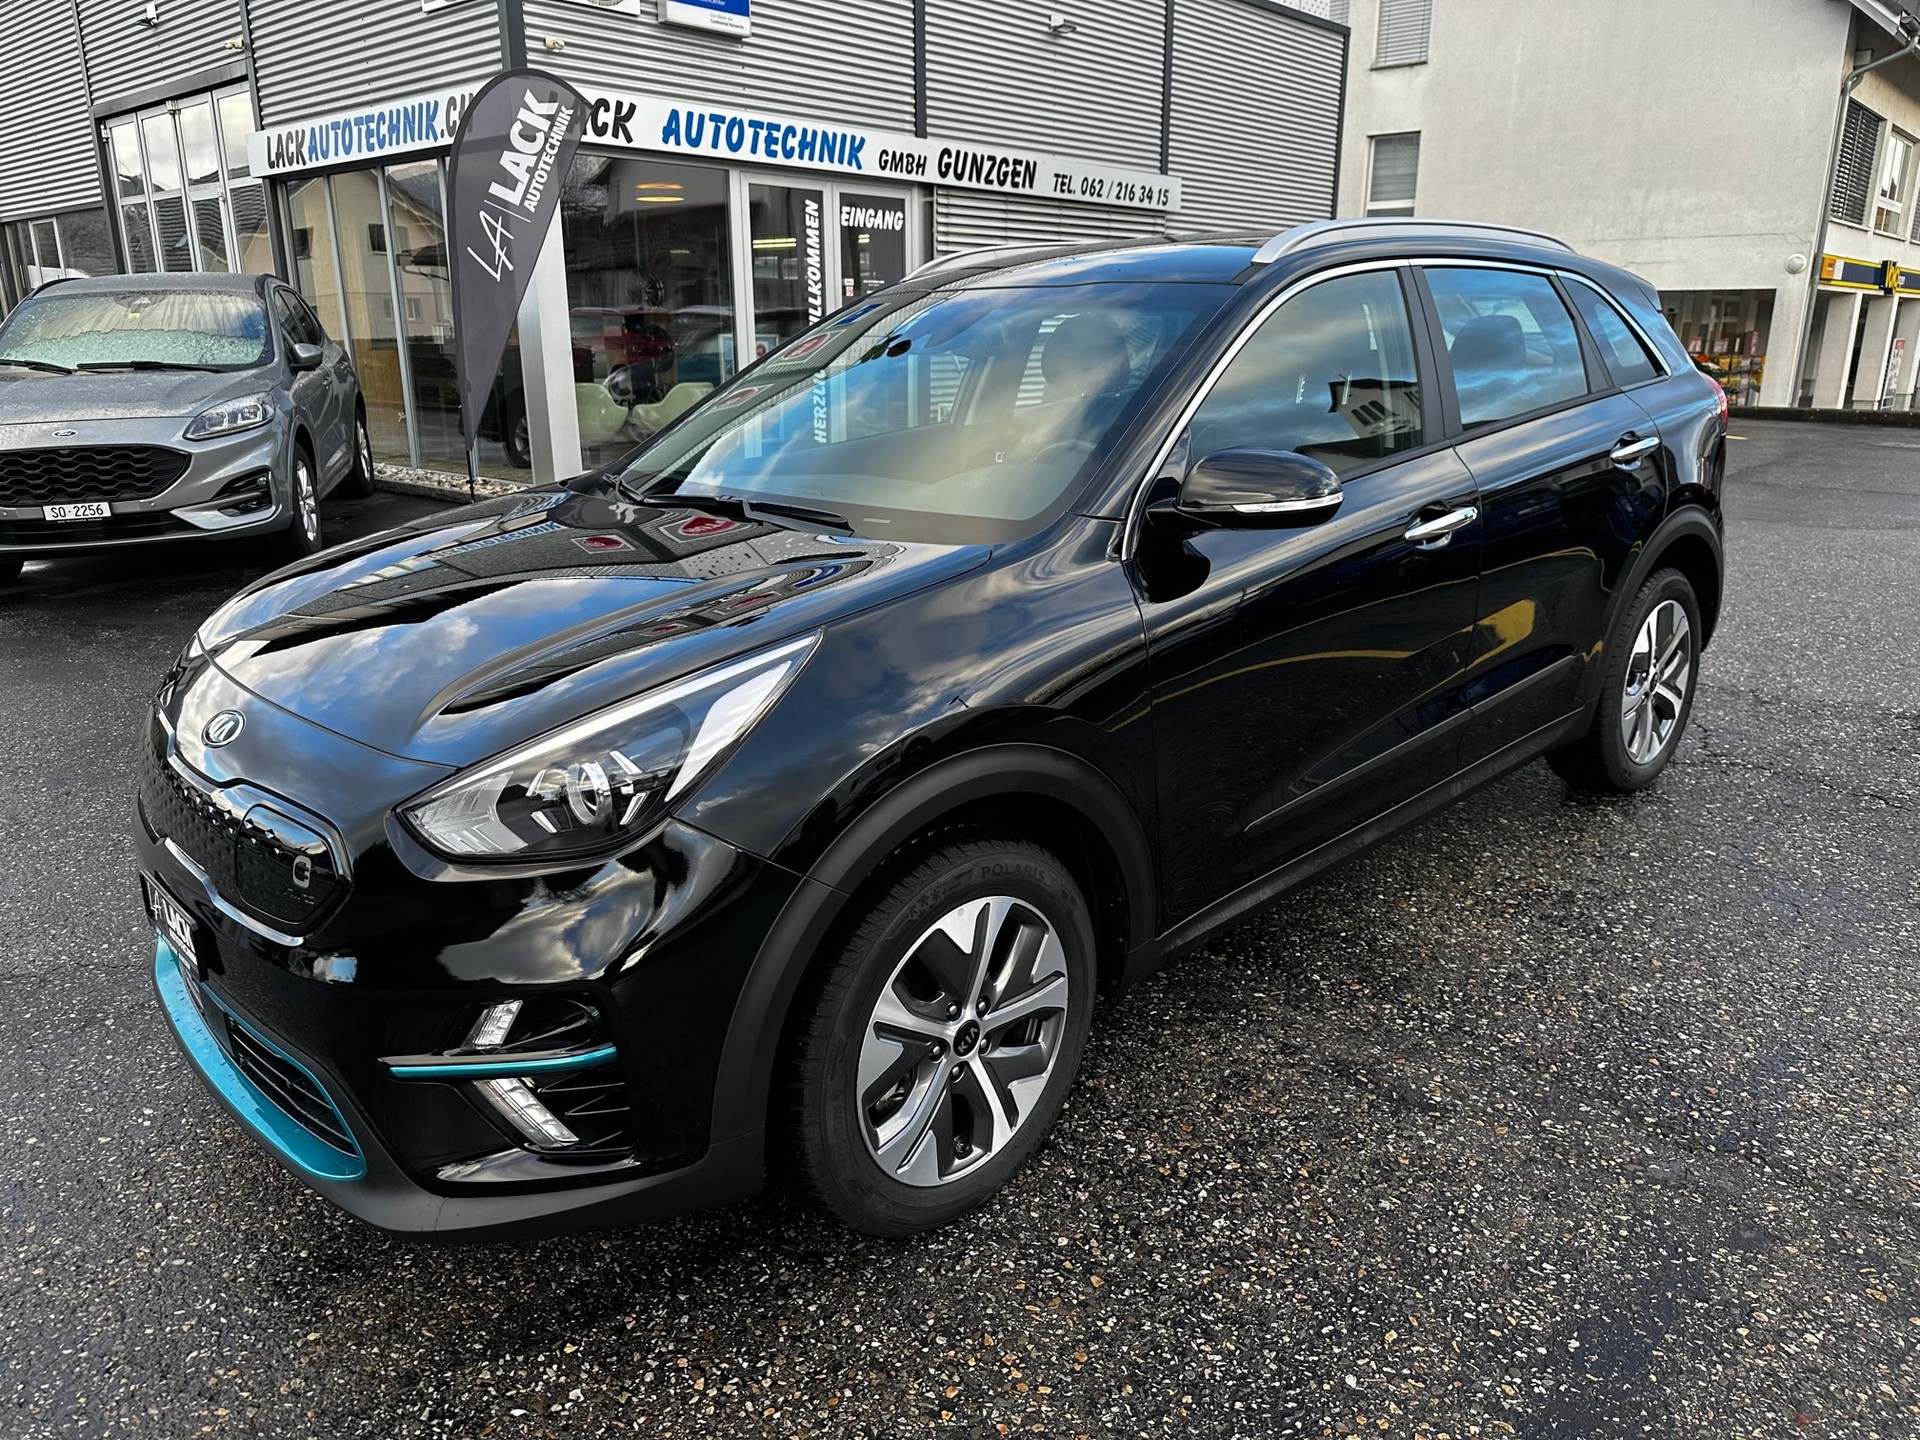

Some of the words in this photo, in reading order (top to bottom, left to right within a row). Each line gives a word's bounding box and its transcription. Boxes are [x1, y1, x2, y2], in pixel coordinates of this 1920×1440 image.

[488, 88, 559, 206] LACK
[523, 105, 574, 213] AUTOTECHNIK
[662, 109, 866, 170] AUTOTECHNIK
[937, 147, 1038, 189] GUNZGEN
[1053, 173, 1076, 195] TEL.
[1080, 176, 1104, 199] 062
[1115, 182, 1136, 202] 216
[1139, 187, 1154, 206] 34
[1157, 188, 1170, 207] 15
[804, 199, 822, 326] ILLKOMMEN
[841, 206, 904, 231] EINGANG
[981, 863, 1047, 882] POLARIS
[957, 1027, 979, 1054] KIA
